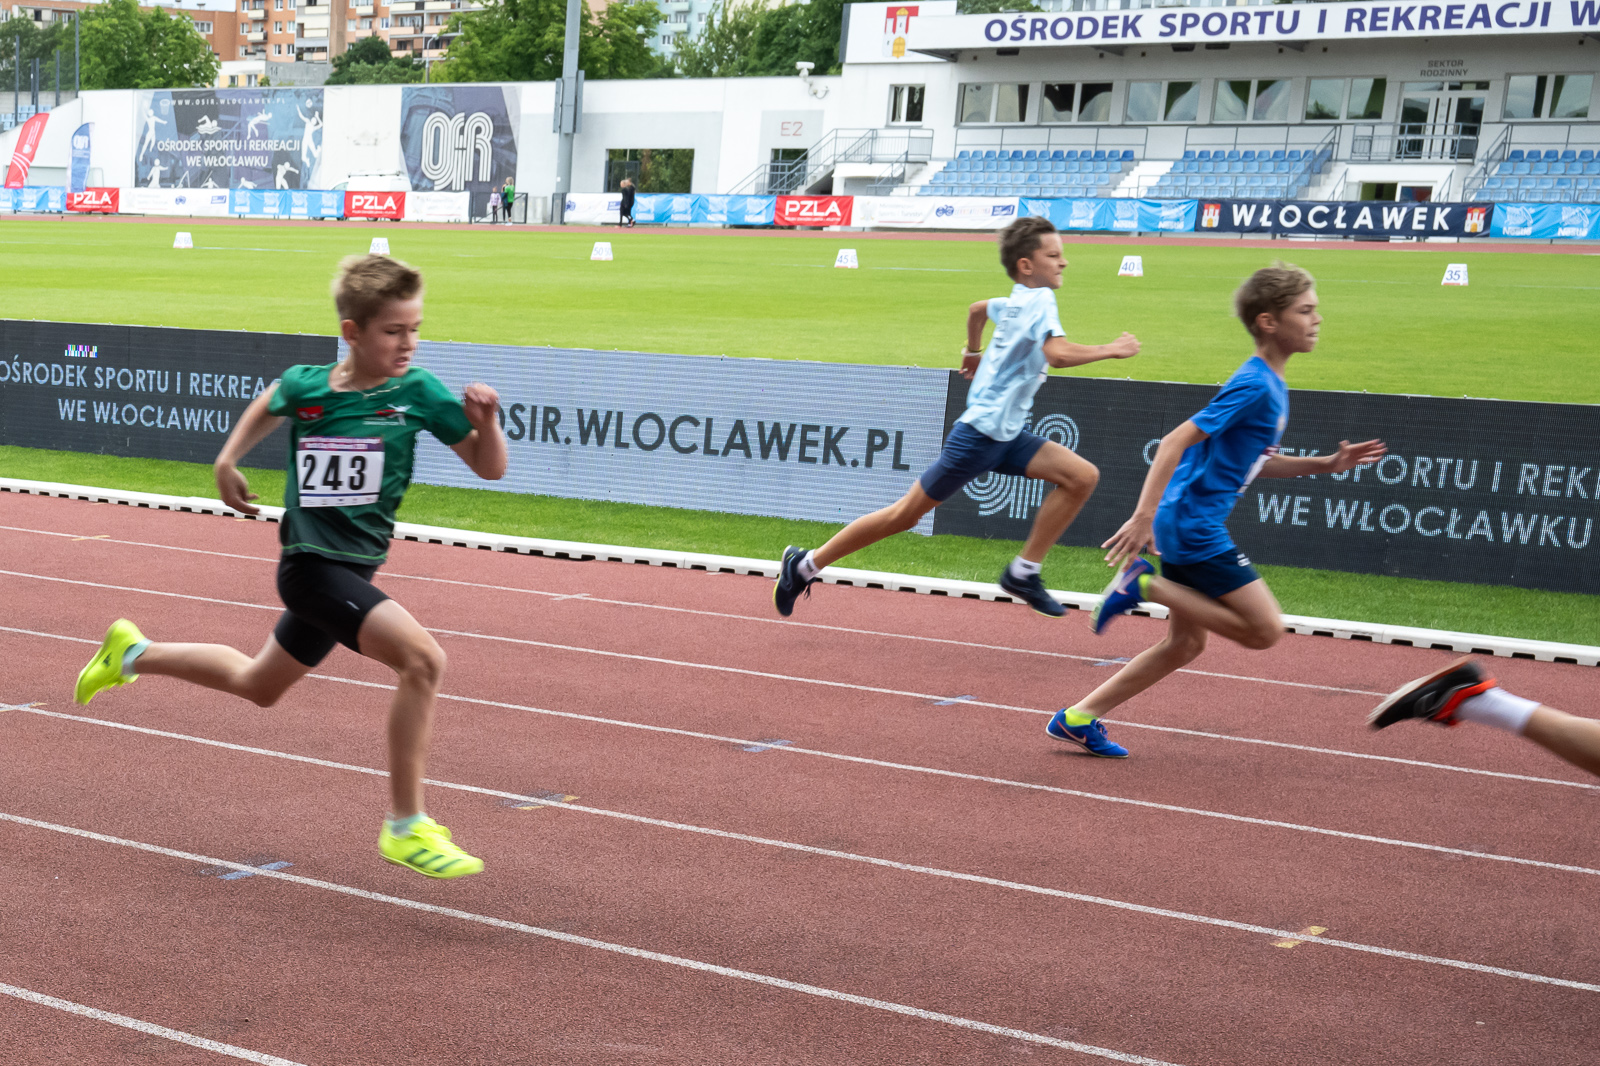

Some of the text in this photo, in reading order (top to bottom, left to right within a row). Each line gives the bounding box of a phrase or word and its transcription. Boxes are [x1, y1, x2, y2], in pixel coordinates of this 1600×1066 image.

[984, 14, 1144, 42] OŚRODEK
[1158, 9, 1301, 38] SPORTU
[1317, 9, 1328, 34] I
[1344, 1, 1552, 33] REKREACJI
[1427, 59, 1464, 68] SEKTOR
[1419, 68, 1469, 77] RODZINNY
[780, 121, 804, 137] E2
[157, 138, 300, 151] OŚRODEK SPORTU I REKREACJI
[186, 155, 269, 167] WE WŁOCŁAWKU
[73, 191, 112, 205] PZLA
[351, 195, 397, 210] PZLA
[785, 200, 841, 217] PZLA
[1232, 203, 1452, 231] WŁOCŁAWEK
[593, 247, 603, 256] 50
[837, 254, 849, 264] 45
[1121, 261, 1135, 272] 40
[1445, 269, 1461, 281] 35
[93, 366, 169, 394] SPORTU
[176, 371, 182, 395] I
[189, 373, 282, 400] REKREA
[57, 398, 230, 434] WE WŁOCŁAWKU
[302, 454, 367, 491] 243
[1492, 461, 1502, 492] I
[1517, 462, 1600, 500] REK
[1257, 493, 1592, 550] WE WŁOCŁAWKU
